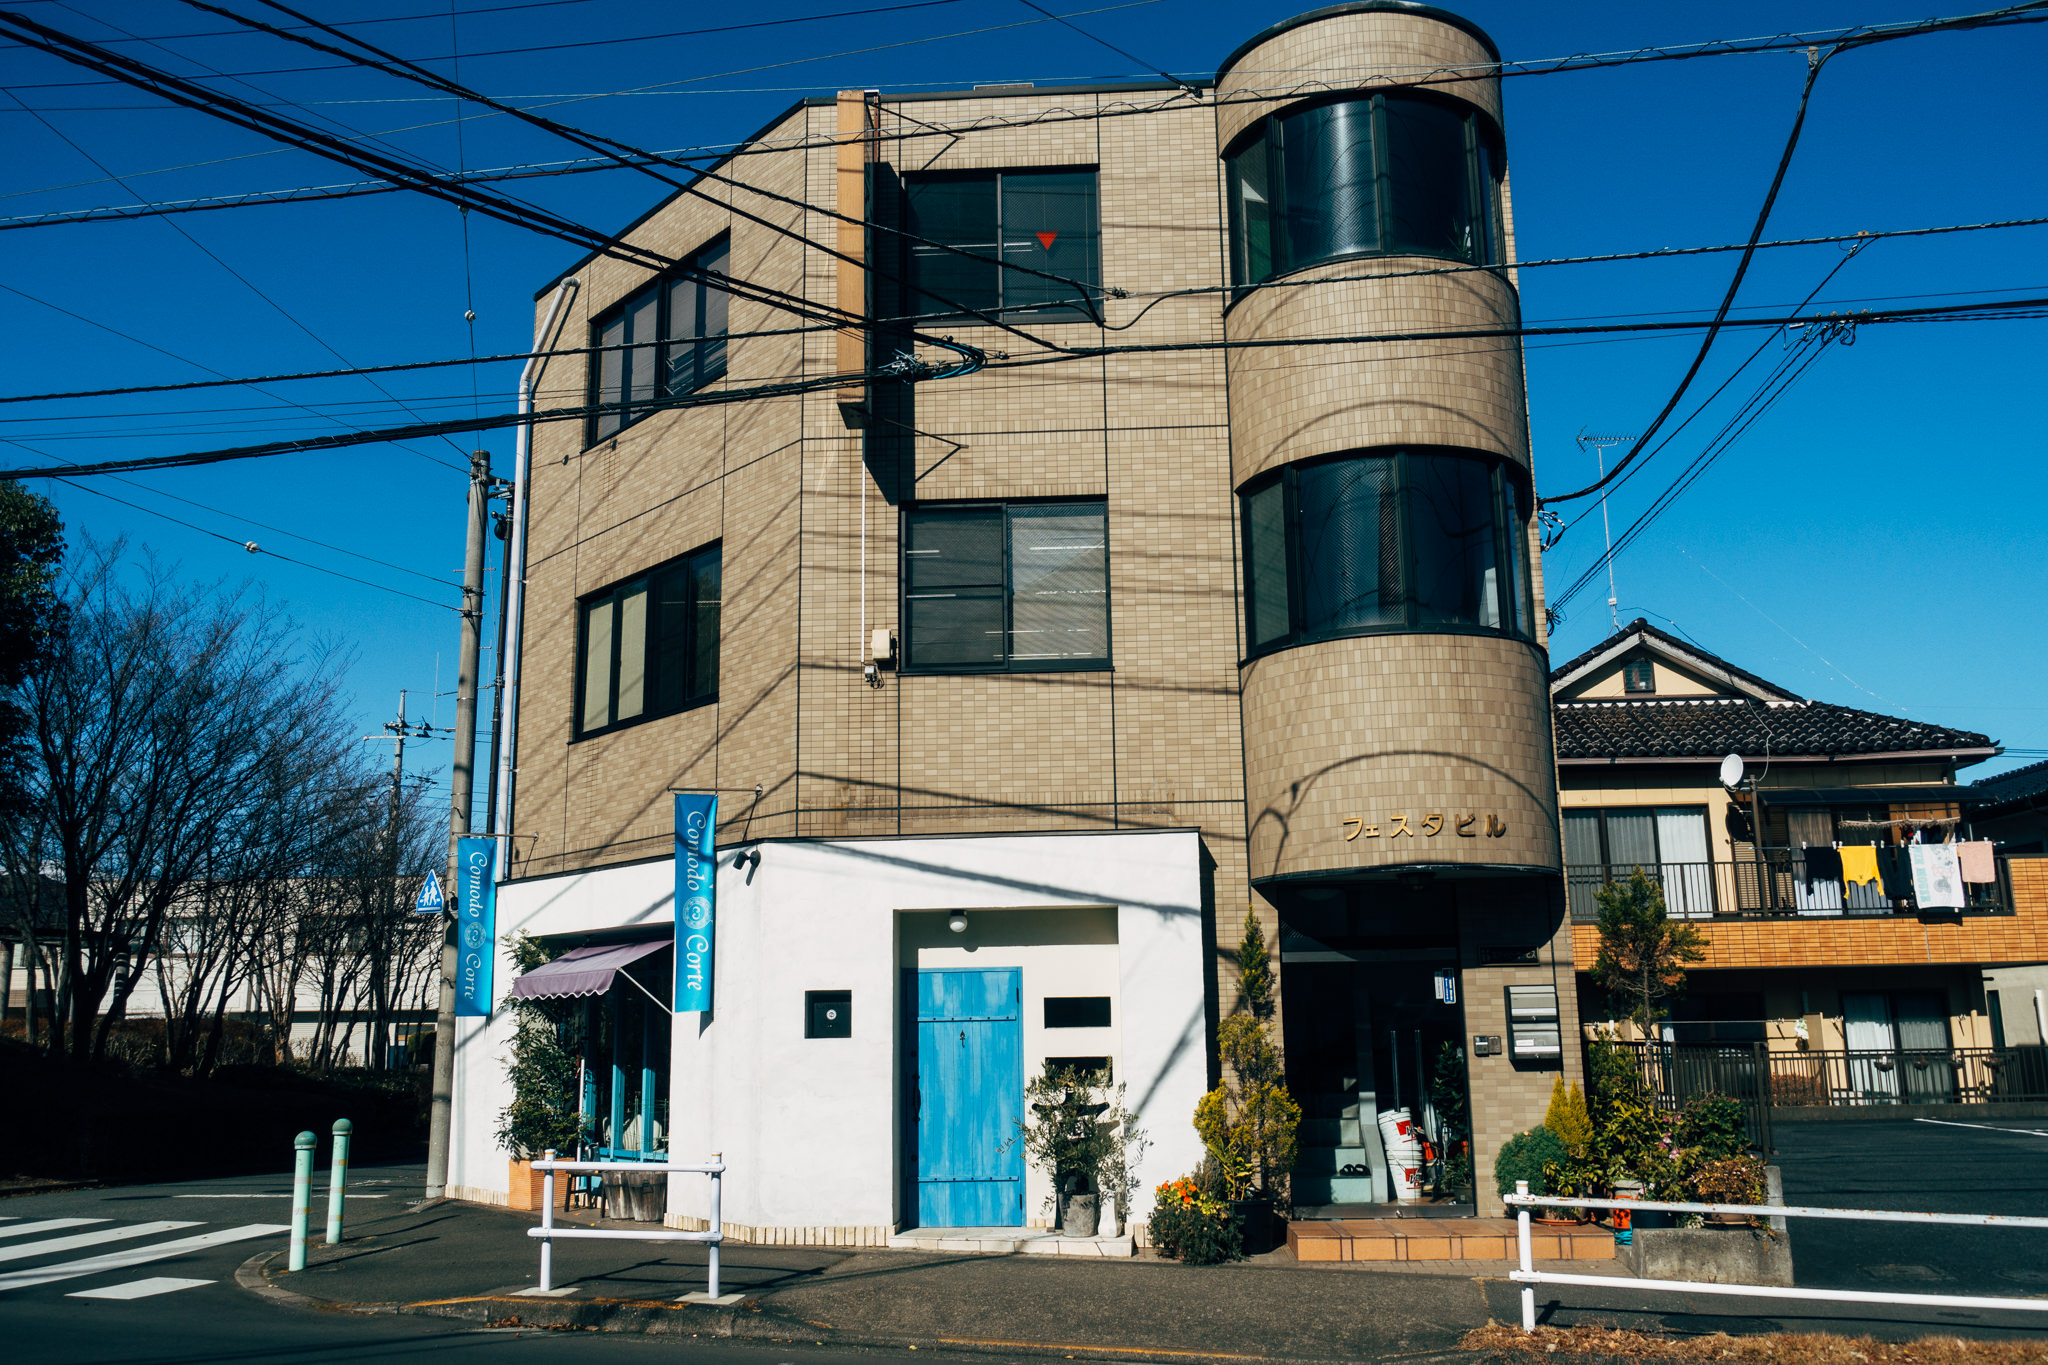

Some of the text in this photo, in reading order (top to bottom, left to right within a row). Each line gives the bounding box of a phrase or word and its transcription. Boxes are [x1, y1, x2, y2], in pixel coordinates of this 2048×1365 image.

[687, 811, 709, 991] Comodo Corte
[1343, 813, 1507, 842] フェスタビル
[465, 851, 488, 1000] Comodo Corte
